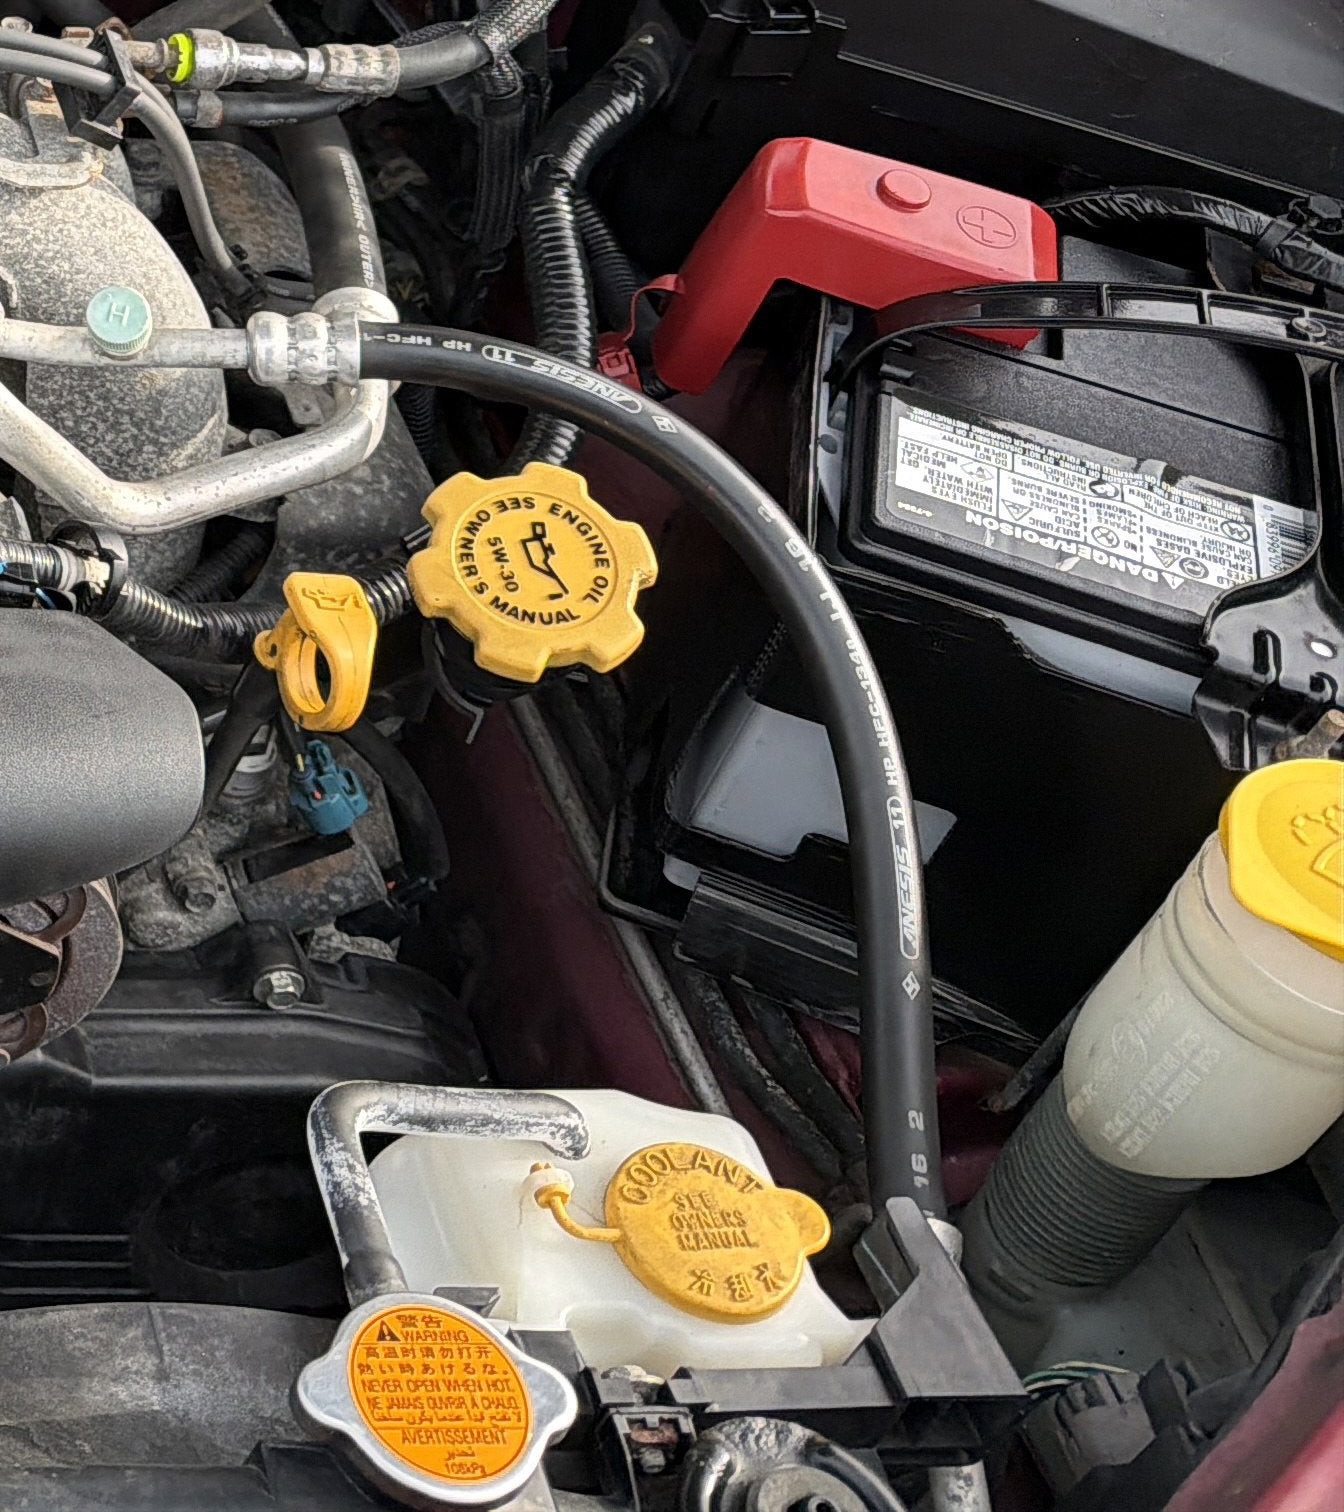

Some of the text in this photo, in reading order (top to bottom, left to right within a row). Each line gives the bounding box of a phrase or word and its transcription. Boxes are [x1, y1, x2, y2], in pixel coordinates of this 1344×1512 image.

[108, 301, 131, 327] H
[442, 339, 472, 352] HP
[899, 447, 946, 469] MEDICAL
[899, 455, 919, 468] GET
[931, 449, 958, 464] HELP
[982, 445, 1007, 459] OPEN
[922, 474, 992, 504] IMMEDIATELY
[965, 479, 993, 495] WITH
[960, 493, 992, 512] FLUSH
[1028, 516, 1080, 538] SULFURIC
[1054, 514, 1080, 529] ACID
[548, 502, 611, 606] ENGINE OIL
[964, 509, 1159, 583] DANGER/POISON
[1123, 539, 1137, 552] NO
[458, 496, 582, 626] SEE OWNER'S MANUAL
[1191, 548, 1252, 574] EXPLOSIVE
[879, 757, 899, 786] HP
[907, 1109, 925, 1132] 2
[619, 1147, 764, 1205] COOLANT
[910, 1153, 930, 1188] 16
[672, 1192, 715, 1213] SEE
[670, 1210, 748, 1232] OWNERS
[675, 1230, 760, 1253] MANUAL
[401, 1329, 469, 1342] WARNING
[362, 1379, 402, 1393] NEVER
[406, 1379, 441, 1393] OPEN
[442, 1379, 483, 1393] WHEN
[402, 1429, 507, 1445] AVERTISSEMENT
